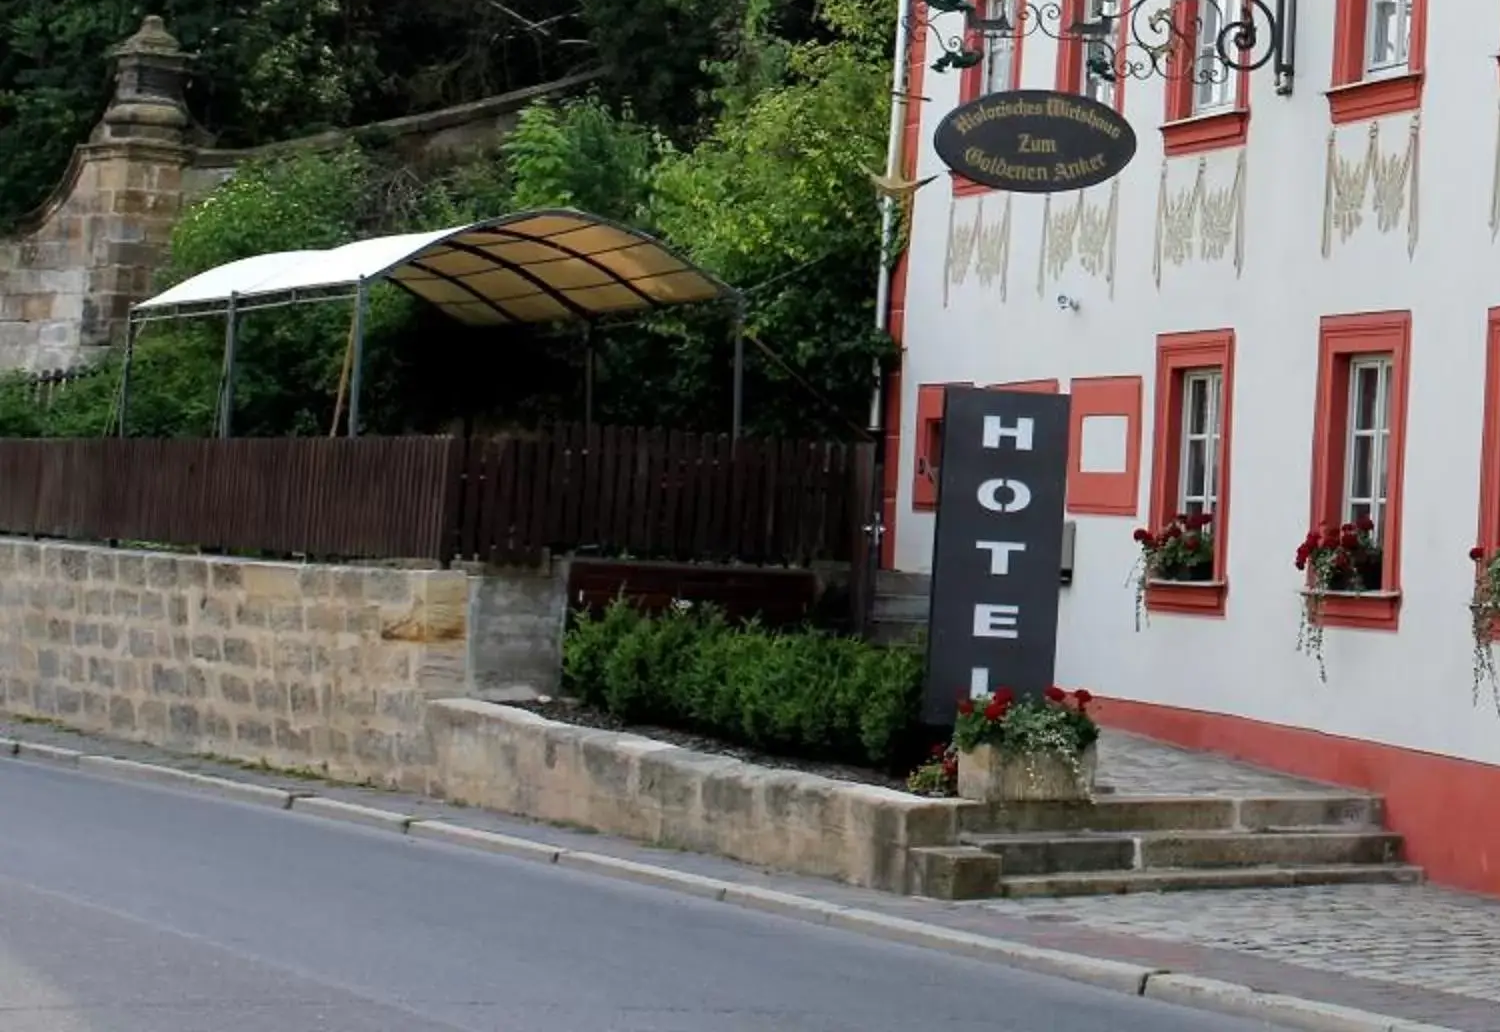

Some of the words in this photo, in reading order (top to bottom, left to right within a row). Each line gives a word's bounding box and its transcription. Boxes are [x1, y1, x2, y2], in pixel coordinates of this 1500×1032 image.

[955, 98, 1044, 135] Historisches
[1046, 98, 1122, 139] Wirtshaus
[1018, 133, 1057, 154] Zum
[964, 146, 1049, 181] Goldenen
[1052, 153, 1108, 181] Anker
[970, 415, 1035, 700] HOTEL
